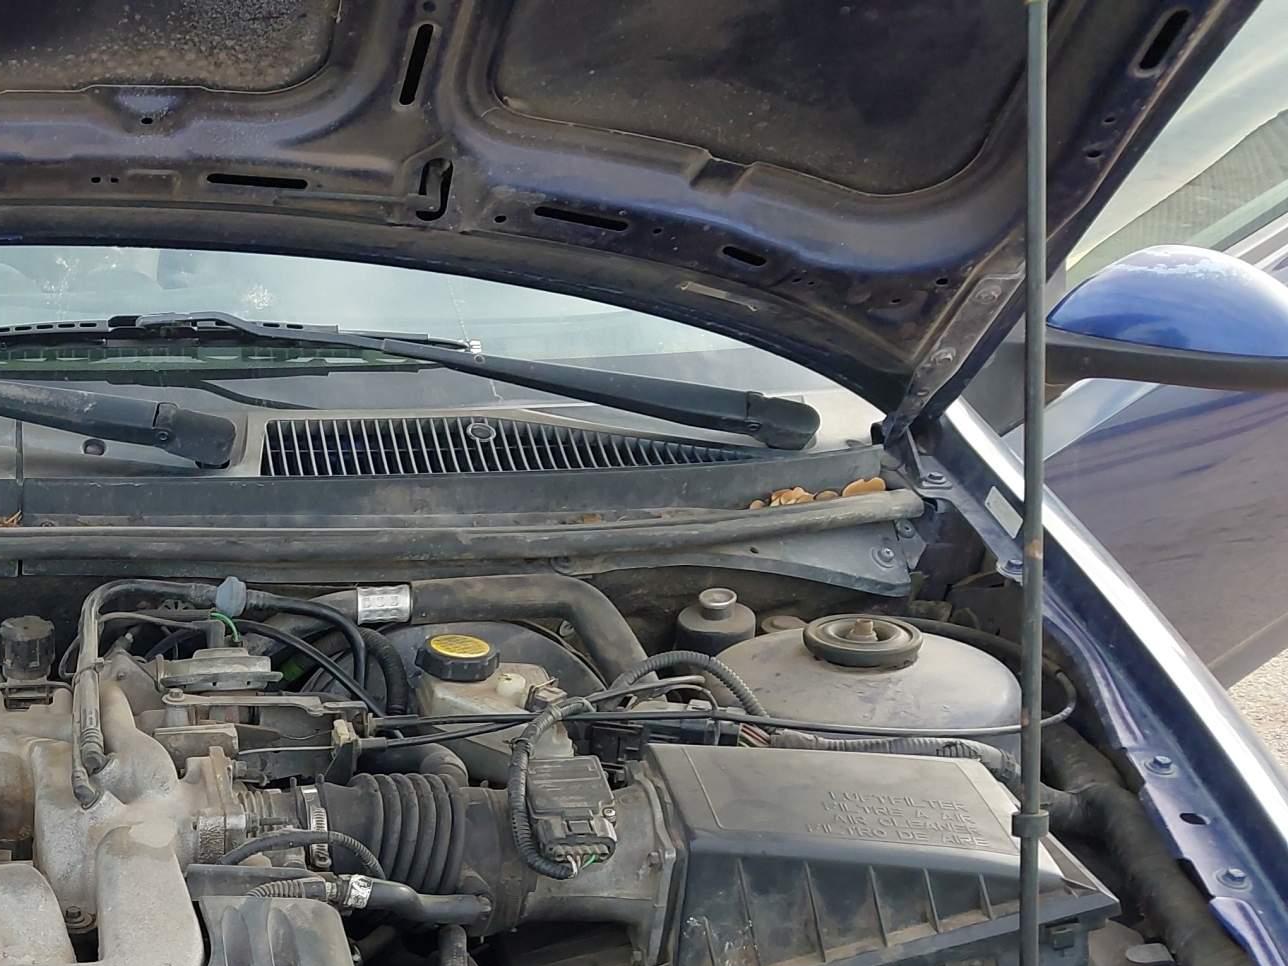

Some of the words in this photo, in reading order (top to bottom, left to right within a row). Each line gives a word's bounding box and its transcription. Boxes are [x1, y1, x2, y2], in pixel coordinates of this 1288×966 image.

[941, 812, 976, 825] AIR
[878, 818, 982, 837] CLEANER
[897, 830, 927, 841] DE
[941, 834, 989, 847] AIRE
